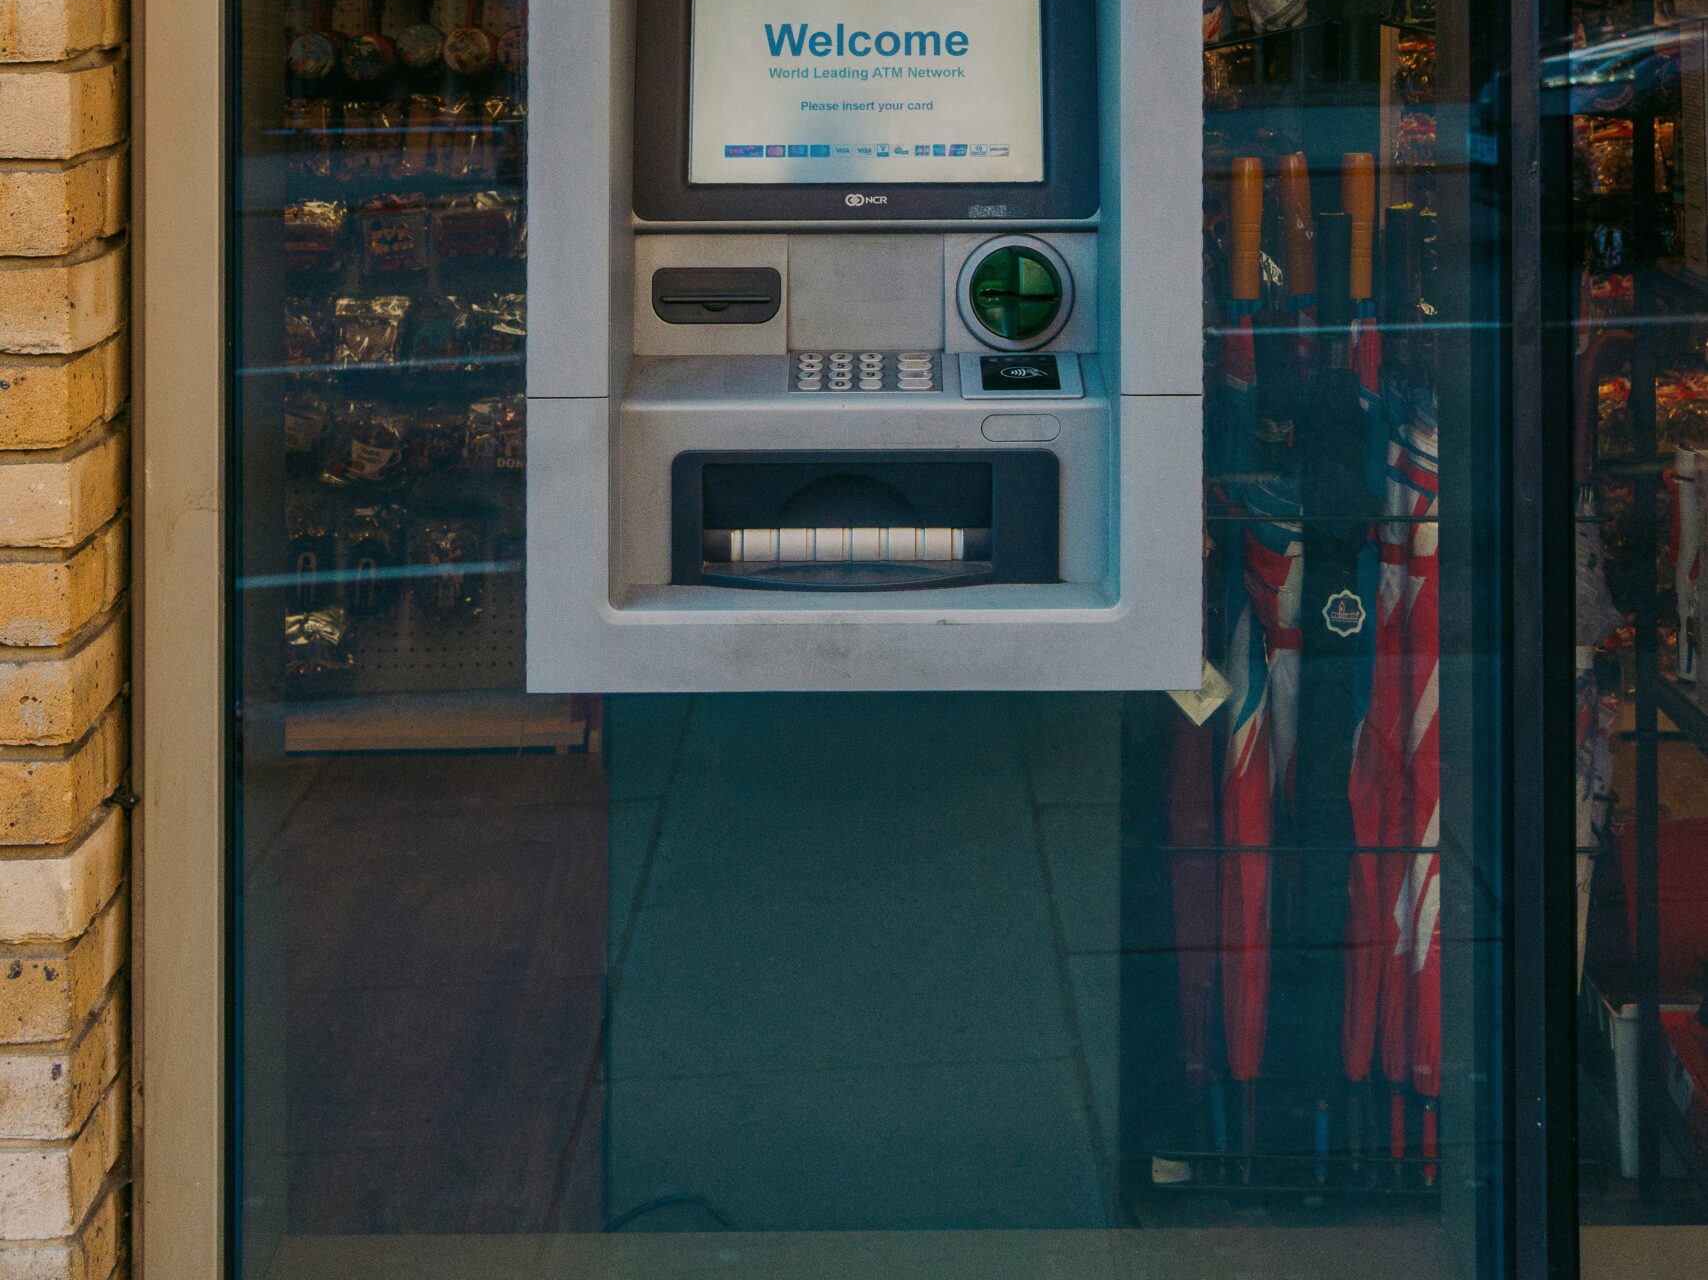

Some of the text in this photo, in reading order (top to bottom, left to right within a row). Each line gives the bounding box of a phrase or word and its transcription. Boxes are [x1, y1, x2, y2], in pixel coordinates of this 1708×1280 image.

[765, 24, 969, 57] Welcome
[769, 67, 965, 81] World Leading ATM Network
[801, 101, 933, 113] Please insert your card
[865, 196, 888, 204] NCR
